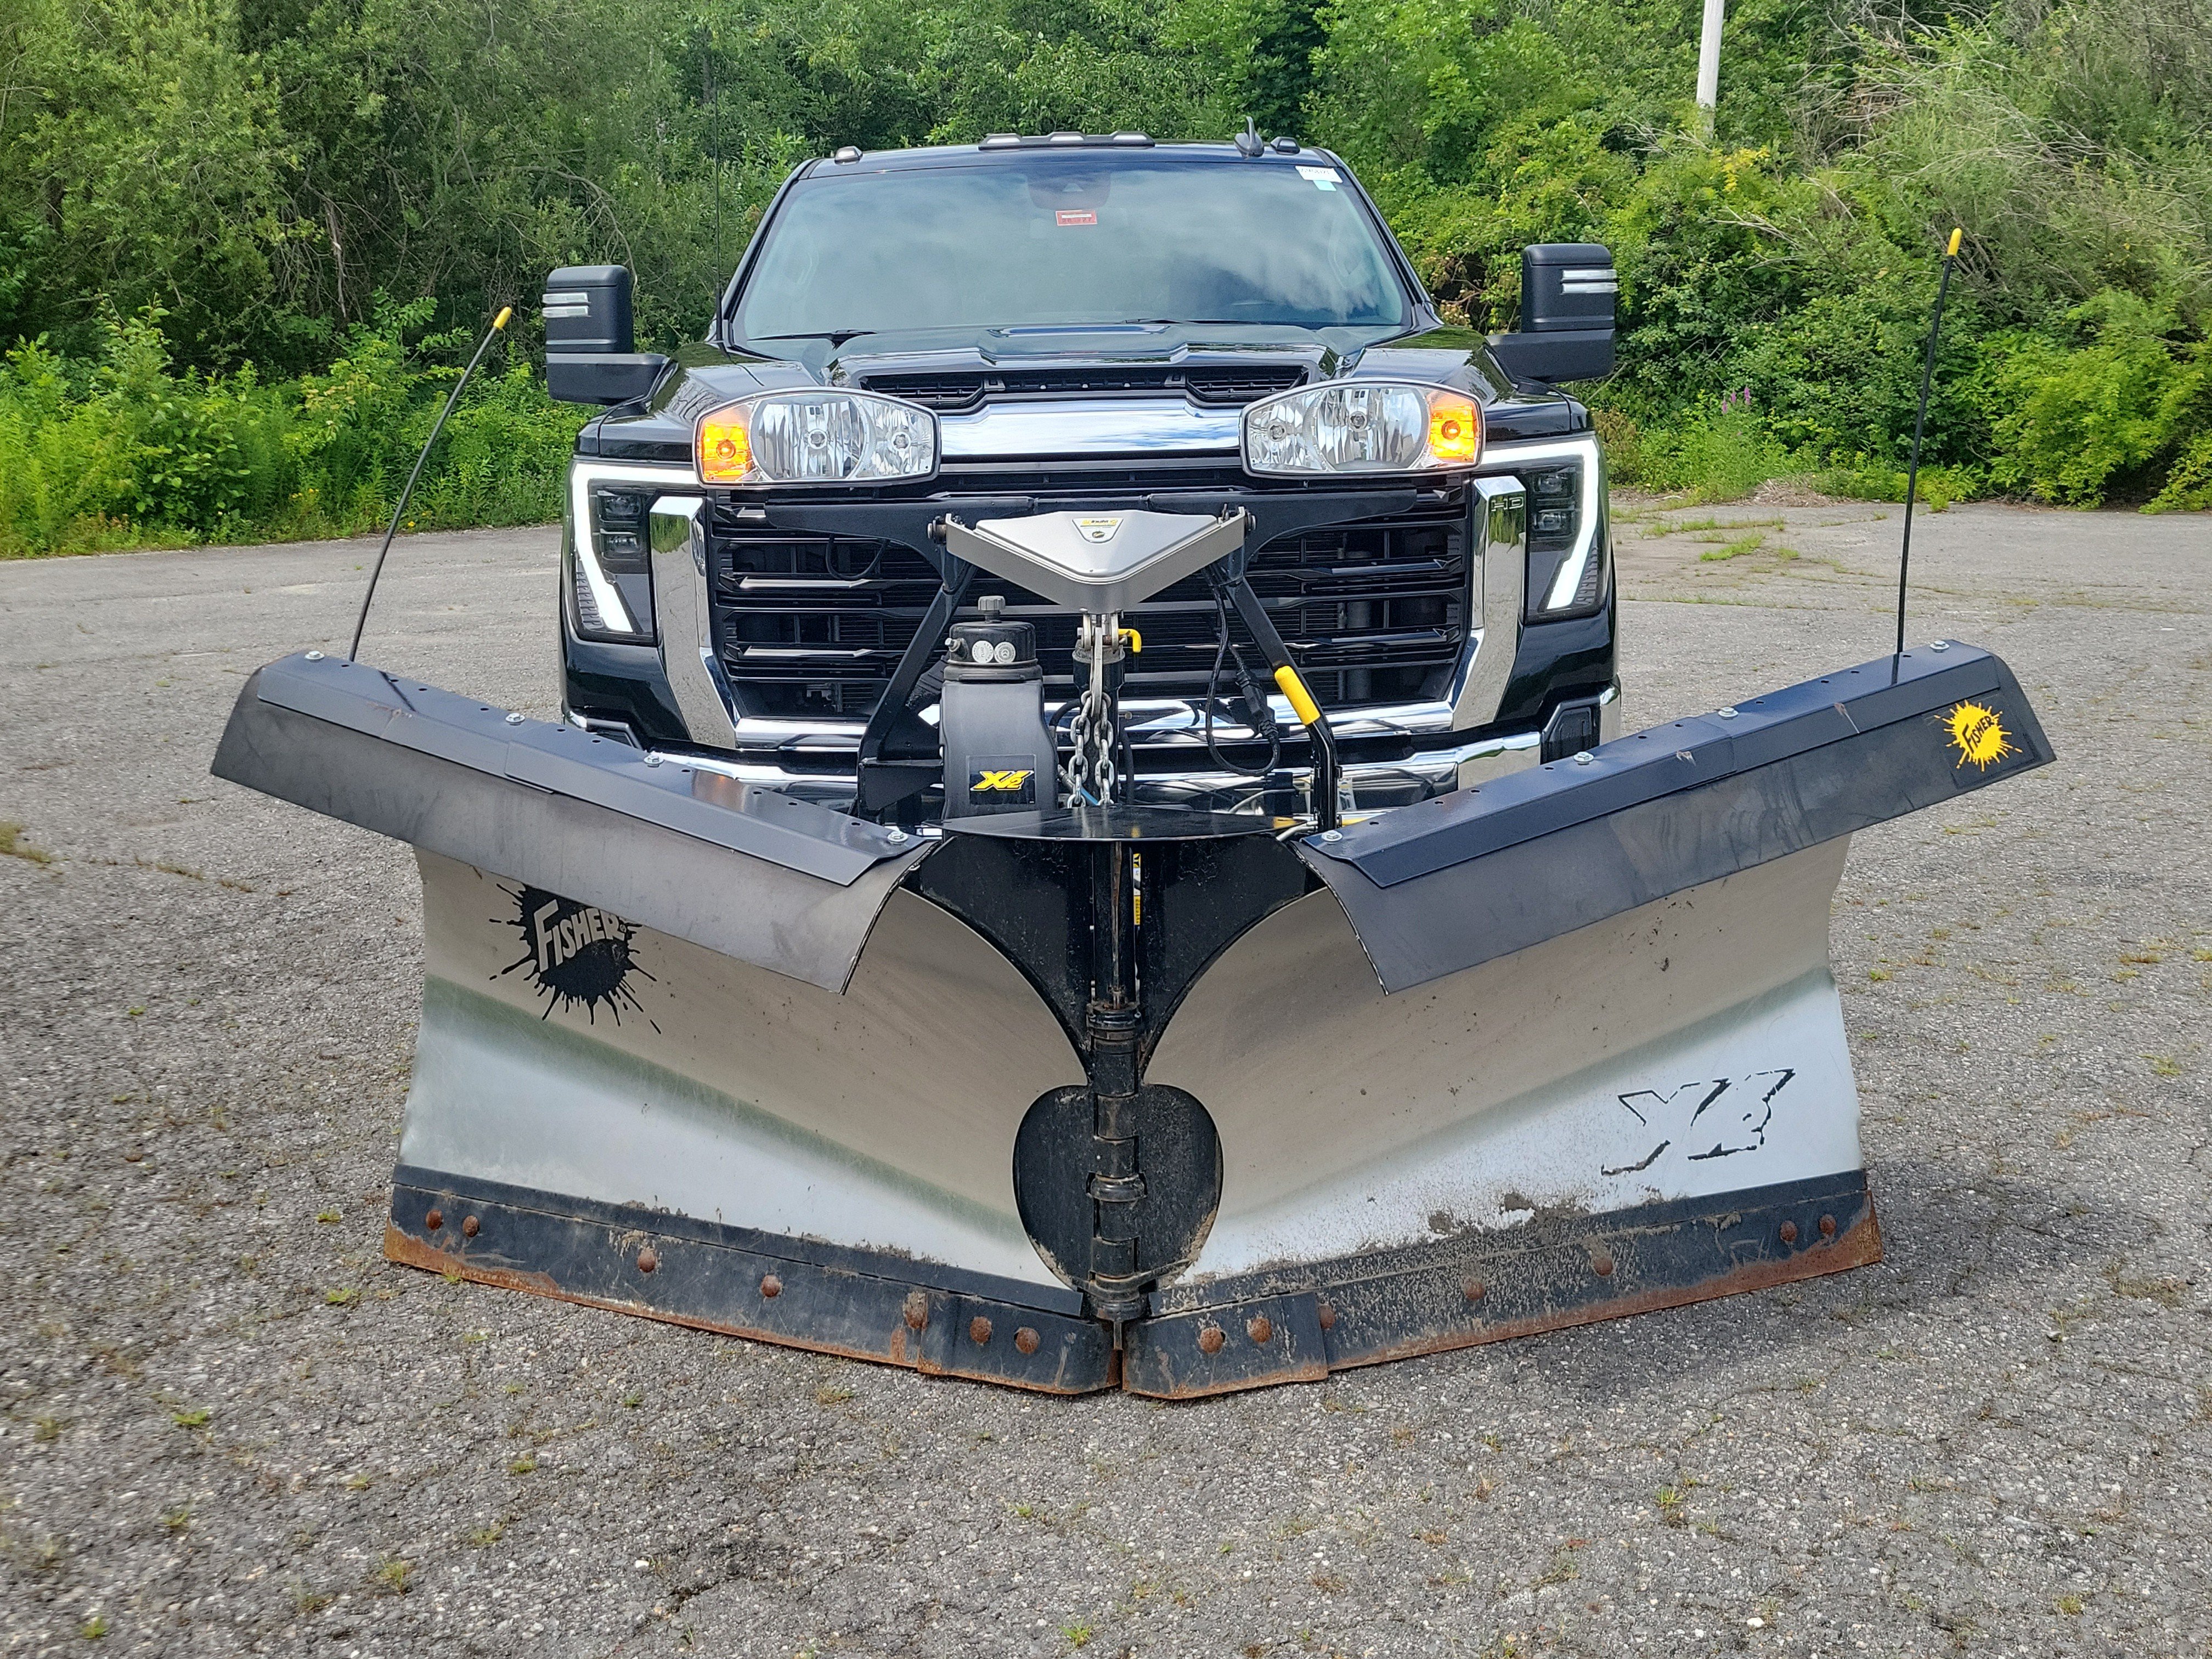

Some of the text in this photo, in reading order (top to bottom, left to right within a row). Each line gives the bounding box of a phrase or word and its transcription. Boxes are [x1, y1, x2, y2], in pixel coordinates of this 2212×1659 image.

[1491, 496, 1524, 512] HD
[1962, 715, 1995, 754] FISHER
[533, 898, 625, 973] FISHER
